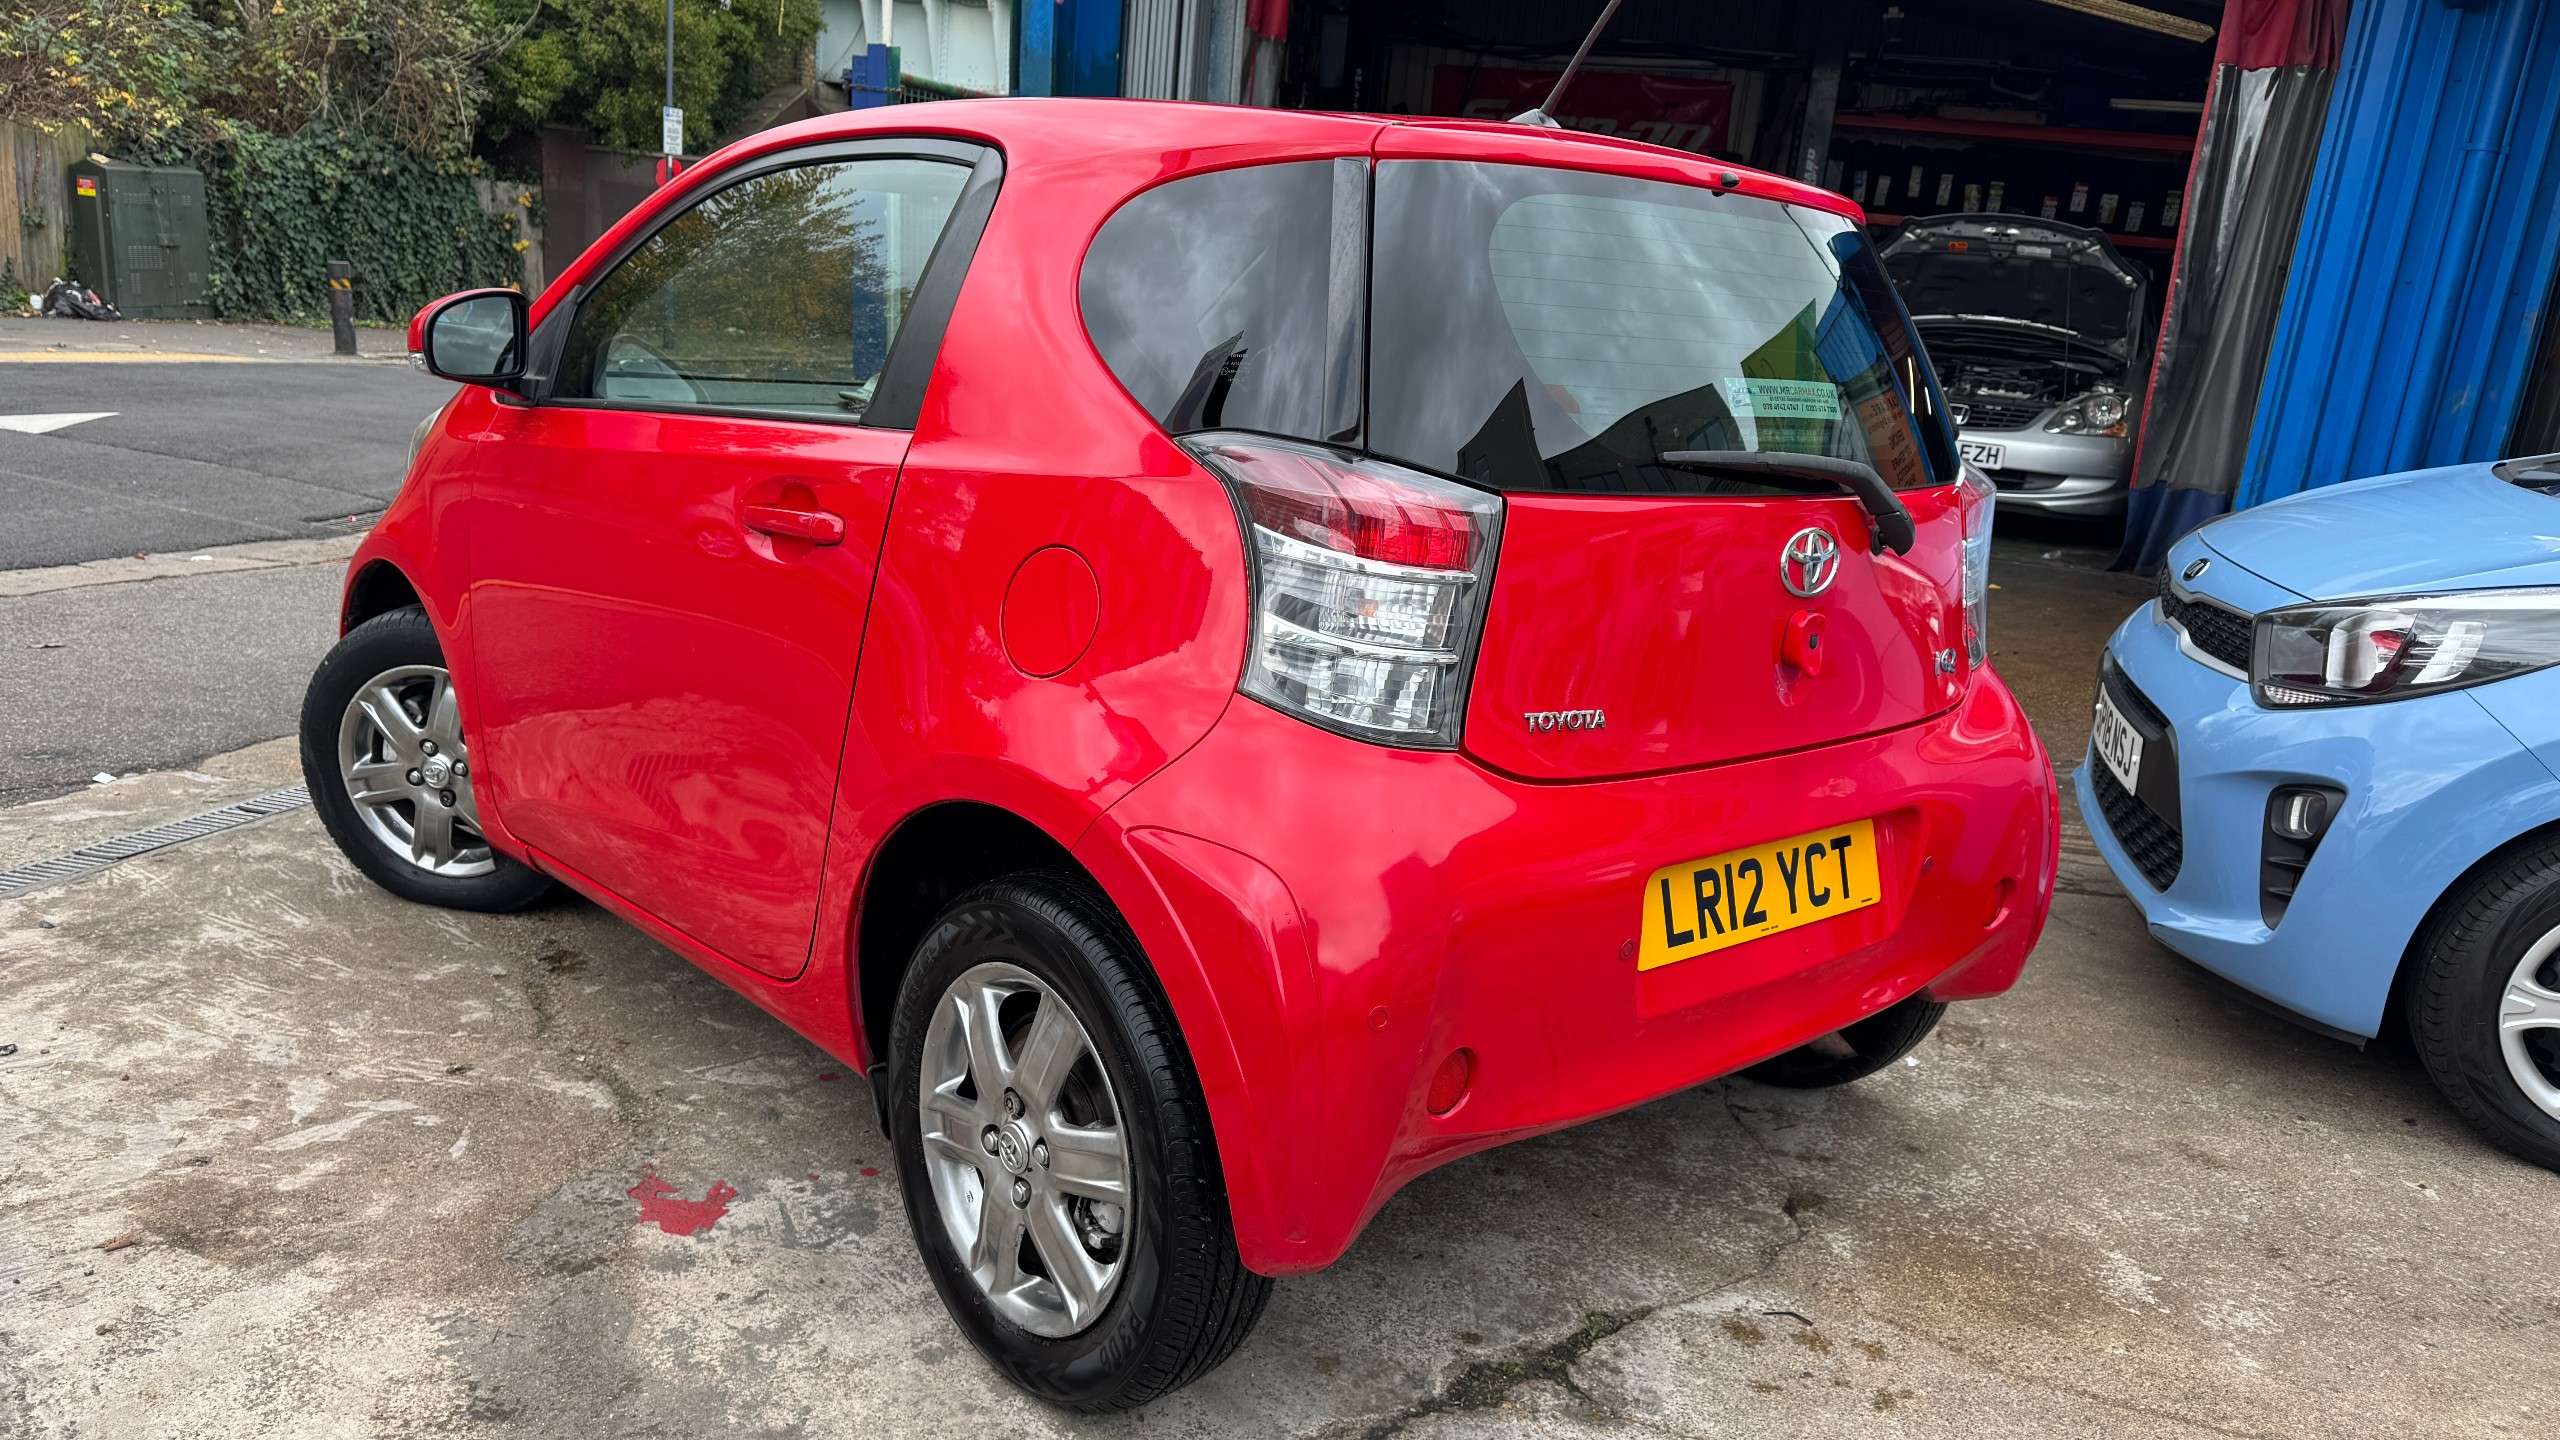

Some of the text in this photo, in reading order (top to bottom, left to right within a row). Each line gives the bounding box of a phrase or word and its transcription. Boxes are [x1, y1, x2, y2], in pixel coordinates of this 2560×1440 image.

[1960, 444, 2000, 465] EZH
[1524, 709, 1606, 734] TOYOTA
[2111, 717, 2135, 778] NSJ
[1660, 834, 1853, 949] LR12 YCT
